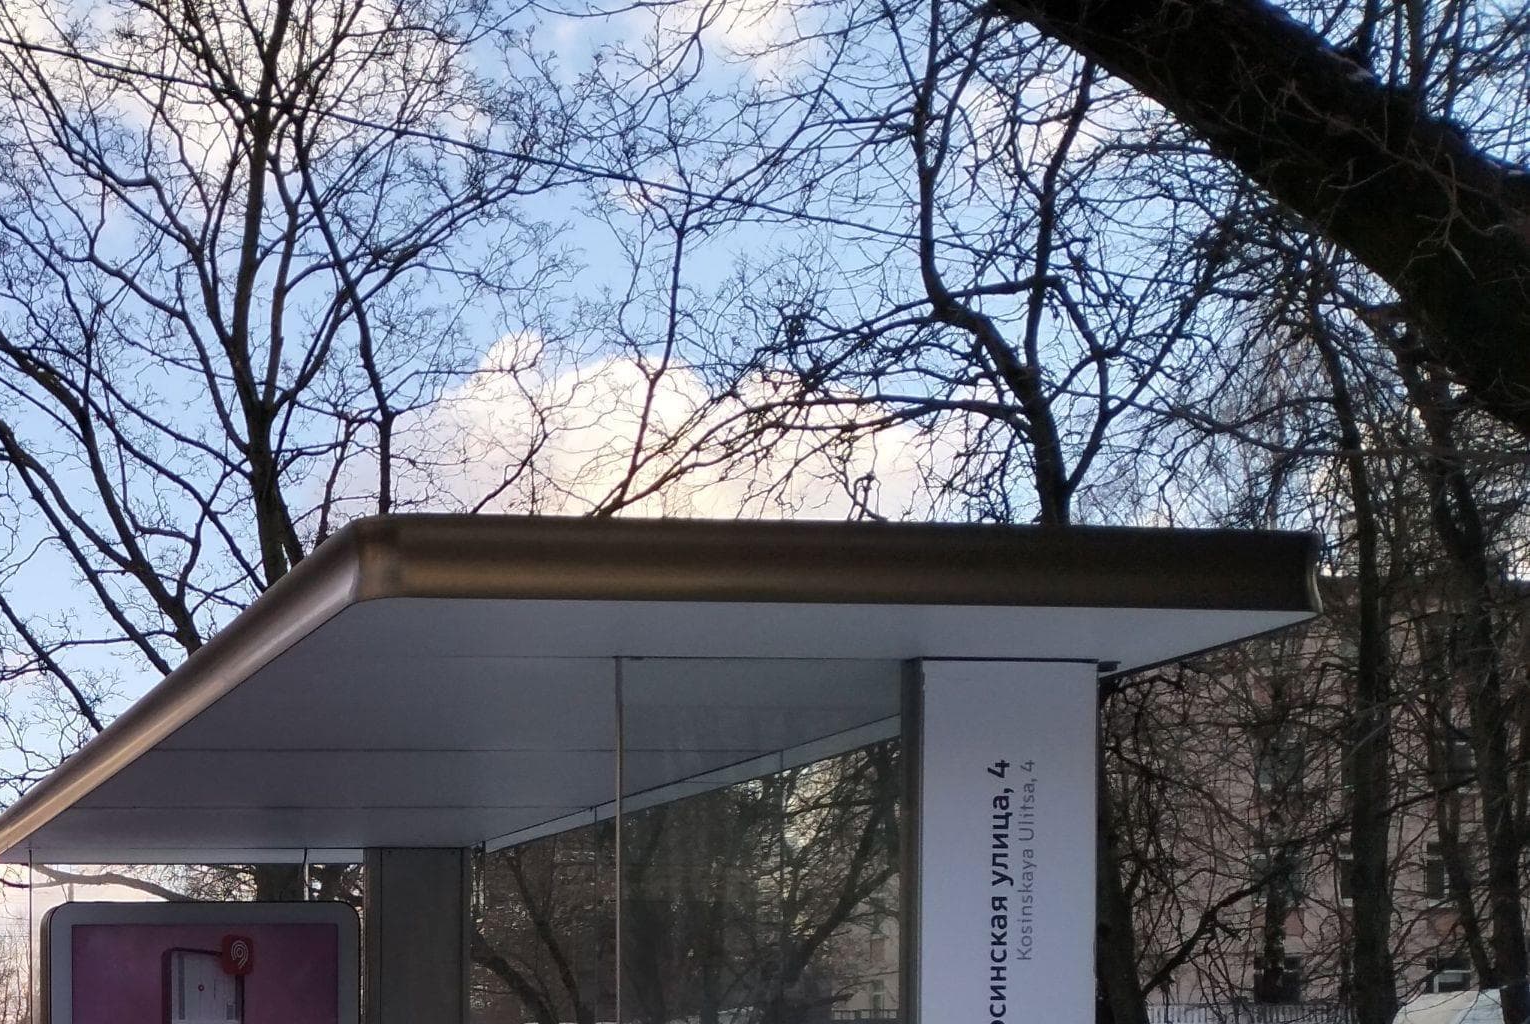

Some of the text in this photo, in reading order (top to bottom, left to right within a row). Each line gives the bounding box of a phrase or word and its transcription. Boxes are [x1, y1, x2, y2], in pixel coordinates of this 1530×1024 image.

[987, 759, 1011, 779] 4
[991, 788, 1015, 886] улица,
[1017, 759, 1038, 960] Kosinskaya Ulitsa, 4
